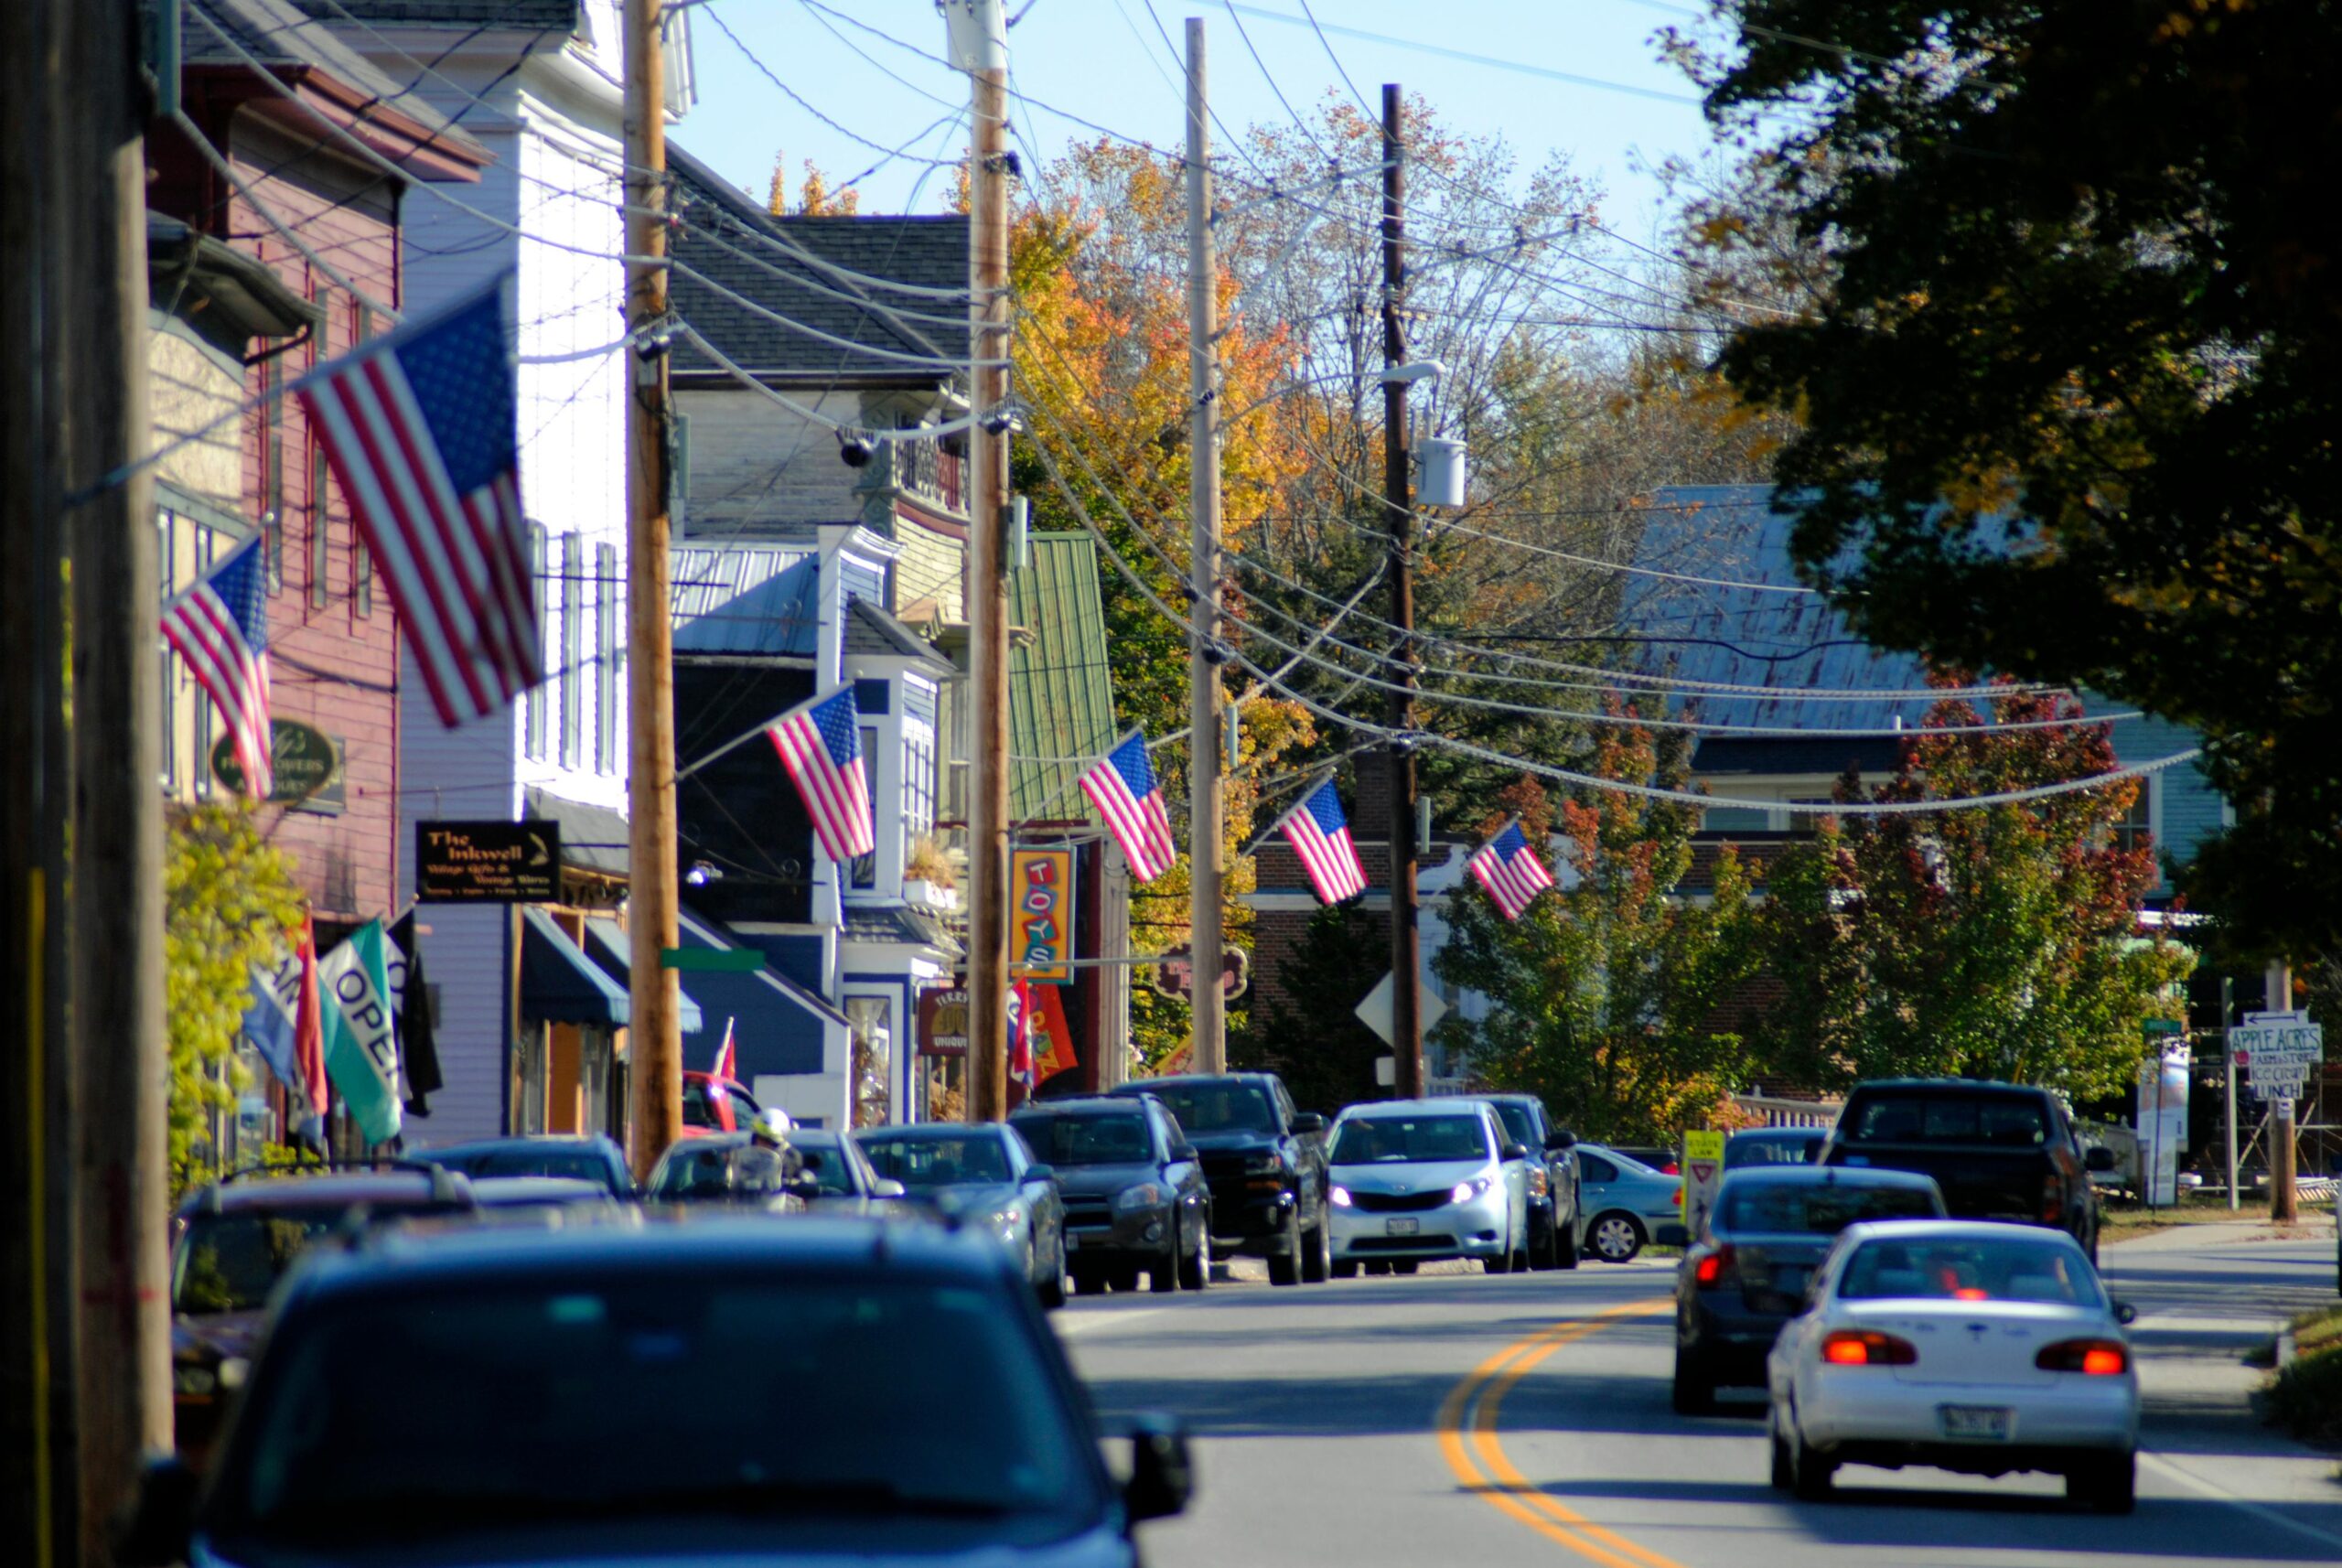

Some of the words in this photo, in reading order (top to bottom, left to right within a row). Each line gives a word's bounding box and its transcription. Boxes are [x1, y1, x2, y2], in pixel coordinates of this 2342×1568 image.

[275, 758, 325, 773] OWERS
[428, 830, 469, 846] The
[448, 845, 522, 861] Inkwell
[1027, 863, 1051, 967] TOYS
[336, 969, 401, 1079] OPE
[2232, 1029, 2274, 1053] APPLE
[2277, 1027, 2321, 1051] ACRES
[2254, 1082, 2300, 1099] LUNCH
